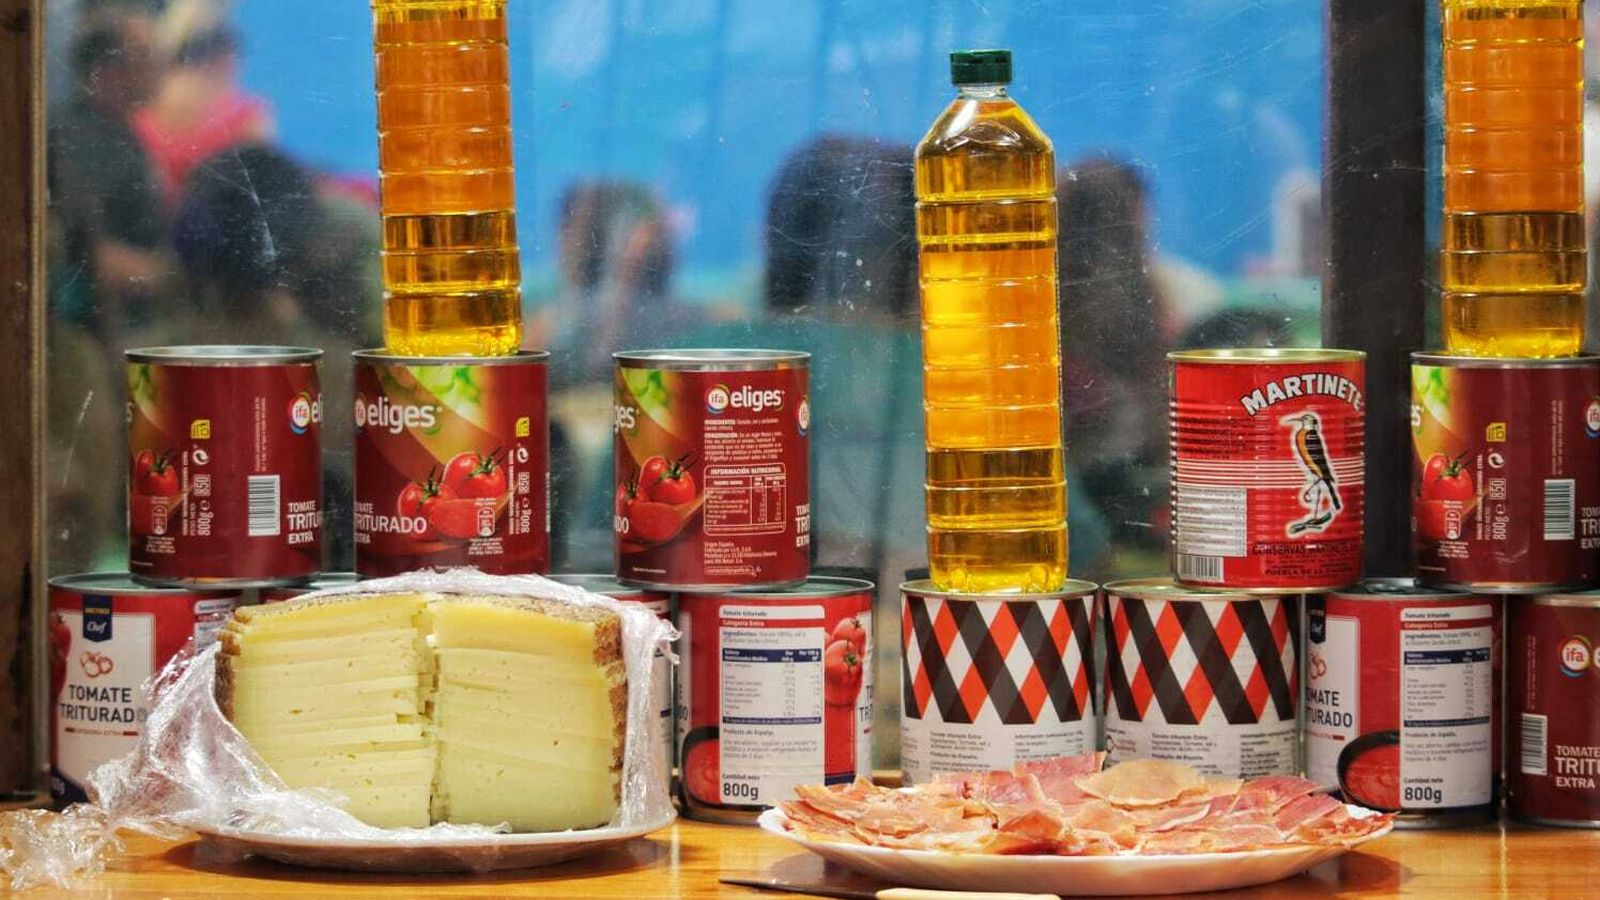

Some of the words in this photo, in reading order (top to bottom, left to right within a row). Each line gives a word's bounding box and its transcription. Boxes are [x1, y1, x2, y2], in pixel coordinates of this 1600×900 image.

[730, 385, 782, 412] eliges
[1240, 373, 1362, 416] MARTINETE
[368, 396, 436, 434] eliges
[288, 500, 316, 512] TOMATE
[196, 511, 214, 536] 800g
[520, 509, 533, 534] 800g
[1491, 516, 1509, 540] 800g
[288, 530, 314, 544] EXTRA
[1565, 647, 1585, 662] ifa
[69, 684, 132, 703] TOMATE
[60, 703, 148, 723] TRITURADO
[723, 782, 759, 801] 800g
[1555, 775, 1597, 790] EXTRA
[1404, 786, 1442, 804] 800g
